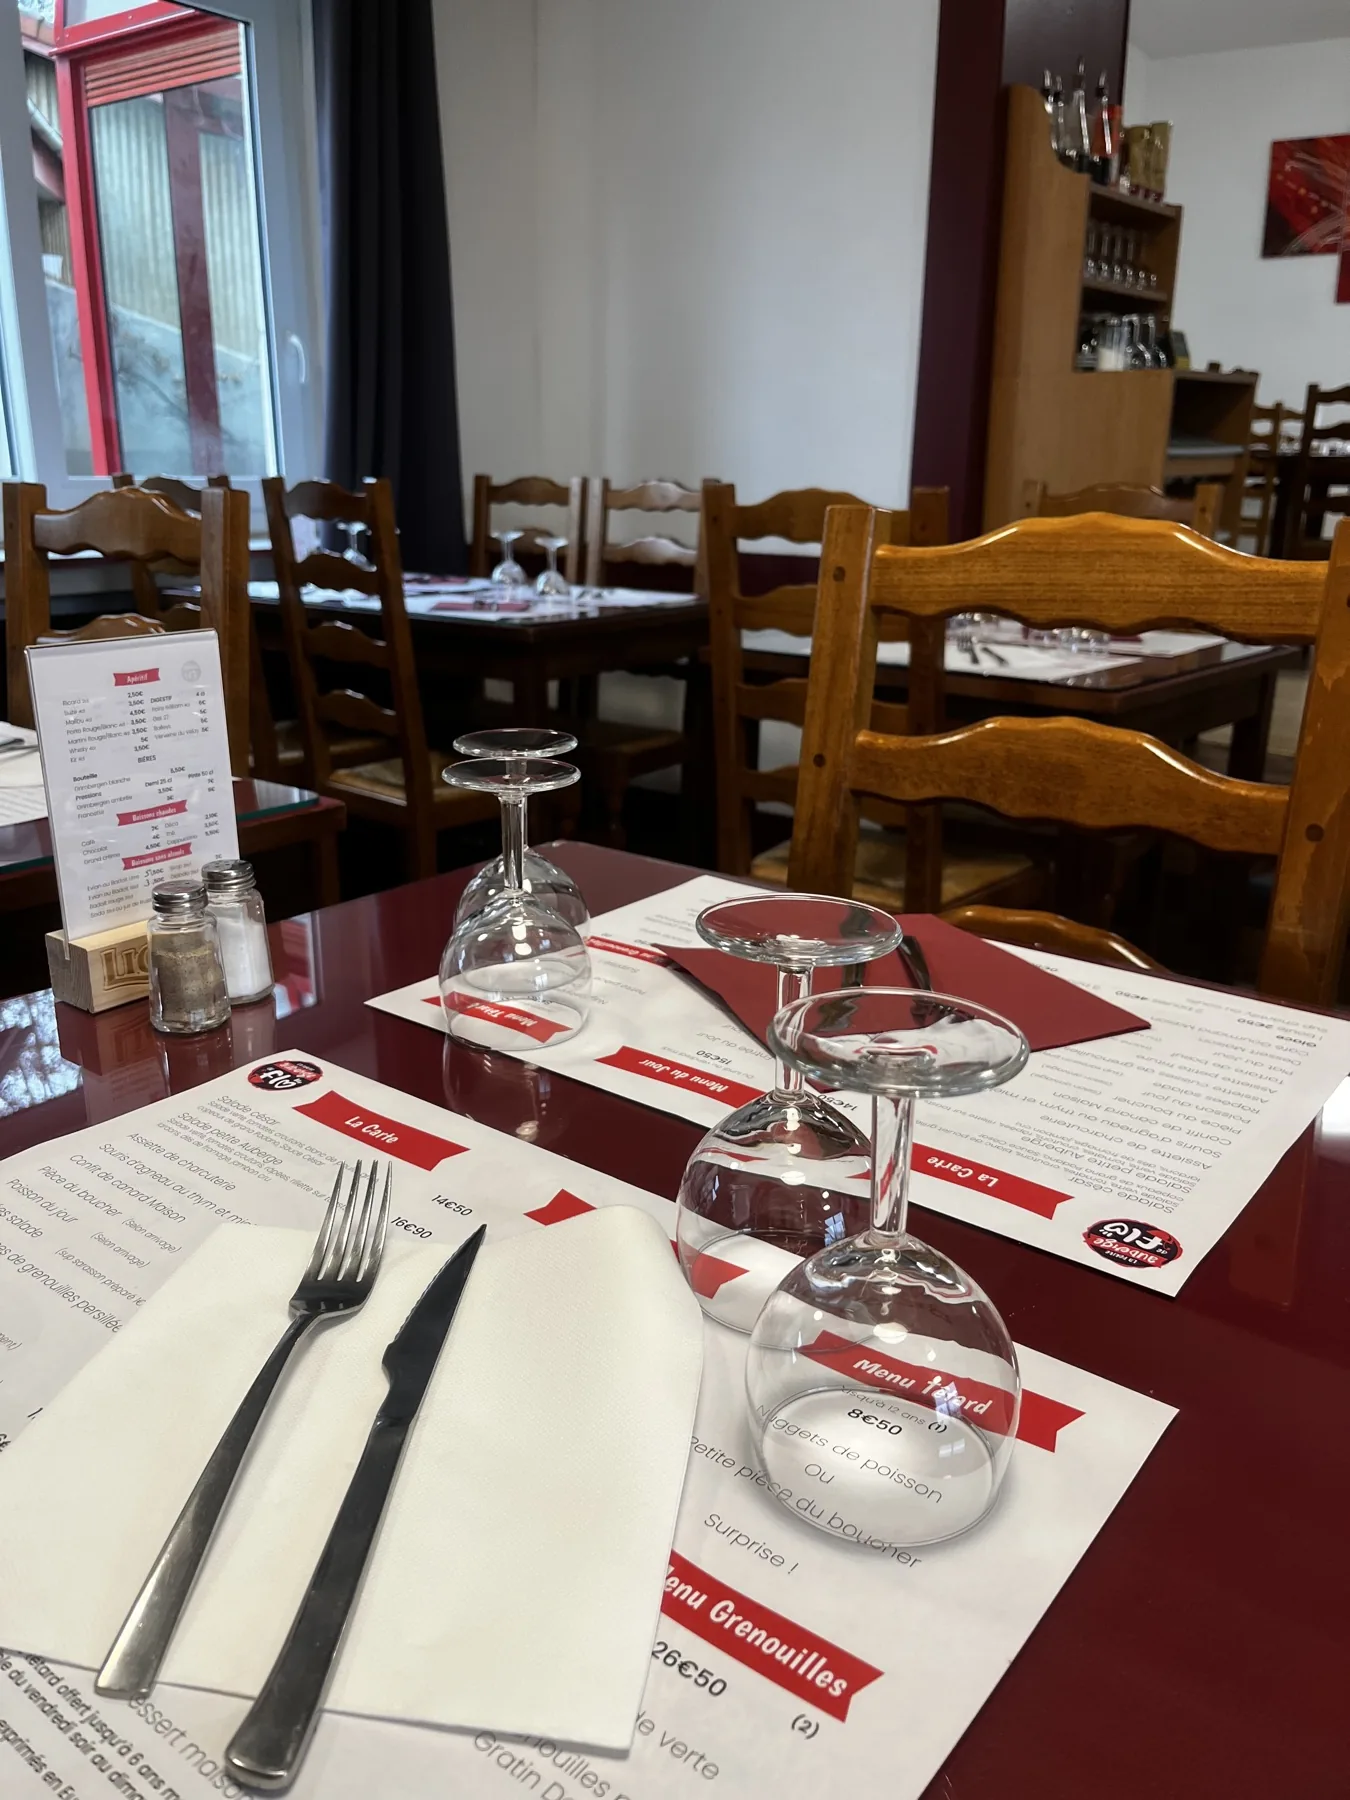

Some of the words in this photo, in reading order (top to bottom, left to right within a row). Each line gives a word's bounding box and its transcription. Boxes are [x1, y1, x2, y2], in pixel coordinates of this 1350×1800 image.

[720, 1040, 736, 1050] du
[638, 1058, 671, 1075] Jour
[670, 1069, 689, 1081] du
[689, 1074, 729, 1093] Menu
[218, 1095, 252, 1113] Salade
[251, 1110, 281, 1126] césar
[1039, 1099, 1075, 1117] thym
[1052, 1091, 1101, 1111] Maison
[1111, 1095, 1174, 1117] boucher
[1172, 1098, 1193, 1109] du
[1078, 1112, 1098, 1122] au
[1103, 1105, 1159, 1127] canard
[1176, 1112, 1197, 1123] du
[1195, 1103, 1252, 1125] Poisson
[344, 1116, 363, 1128] La
[361, 1124, 399, 1144] Carte
[1039, 1114, 1123, 1144] charcuterie
[1161, 1122, 1183, 1133] de
[1186, 1128, 1233, 1146] Confit
[1200, 1119, 1242, 1135] Pièce
[177, 1112, 213, 1131] Salade
[208, 1124, 240, 1145] petite
[240, 1141, 283, 1166] Auberge
[1020, 1135, 1083, 1160] Auberge
[1126, 1141, 1147, 1152] de
[1176, 1140, 1223, 1159] Souris
[126, 1132, 167, 1155] Assiette
[163, 1149, 180, 1162] de
[178, 1158, 236, 1191] charcuterie
[927, 1156, 973, 1178] Carte
[1087, 1157, 1133, 1176] petite
[1150, 1147, 1213, 1170] Assiette
[6, 1178, 44, 1204] Poisson
[38, 1165, 67, 1185] Pièce
[64, 1181, 82, 1193] du
[76, 1189, 123, 1217] boucher
[69, 1154, 103, 1174] Confit
[97, 1169, 114, 1182] de
[111, 1178, 154, 1202] canard
[146, 1198, 187, 1223] Maison
[99, 1142, 130, 1163] Souris
[127, 1157, 175, 1187] d'agneau
[172, 1183, 189, 1195] au
[187, 1191, 218, 1211] thym
[215, 1206, 231, 1218] et
[977, 1173, 999, 1187] La
[1067, 1176, 1113, 1194] césar
[1135, 1171, 1192, 1194] Salade
[40, 1199, 59, 1213] du
[431, 1194, 473, 1216] 14€50
[1116, 1191, 1174, 1214] Salade
[6, 1212, 44, 1239] salade
[49, 1208, 78, 1224] jour
[391, 1216, 433, 1239] 16€90
[7, 1251, 26, 1265] de
[17, 1263, 81, 1304] grenouilles
[851, 1357, 915, 1391] Menu
[846, 1407, 903, 1437] 8€50
[803, 1462, 837, 1487] Ou
[831, 1441, 861, 1463] de
[859, 1457, 945, 1505] poisson
[734, 1462, 794, 1502] pièce
[795, 1494, 828, 1522] du
[826, 1512, 923, 1570] boucher
[703, 1512, 786, 1569] Surprise
[709, 1599, 849, 1698] Grenouilles
[651, 1641, 729, 1698] 26€50
[8, 1669, 28, 1687] du
[23, 1684, 78, 1735] vendredi
[68, 1732, 96, 1755] soir
[90, 1754, 113, 1773] au
[127, 1691, 188, 1747] essert
[790, 1712, 821, 1741] (2)
[57, 1685, 92, 1716] offert
[128, 1753, 144, 1766] 6
[137, 1764, 165, 1789] ans
[474, 1730, 542, 1790] Gratin
[659, 1730, 720, 1781] verte
